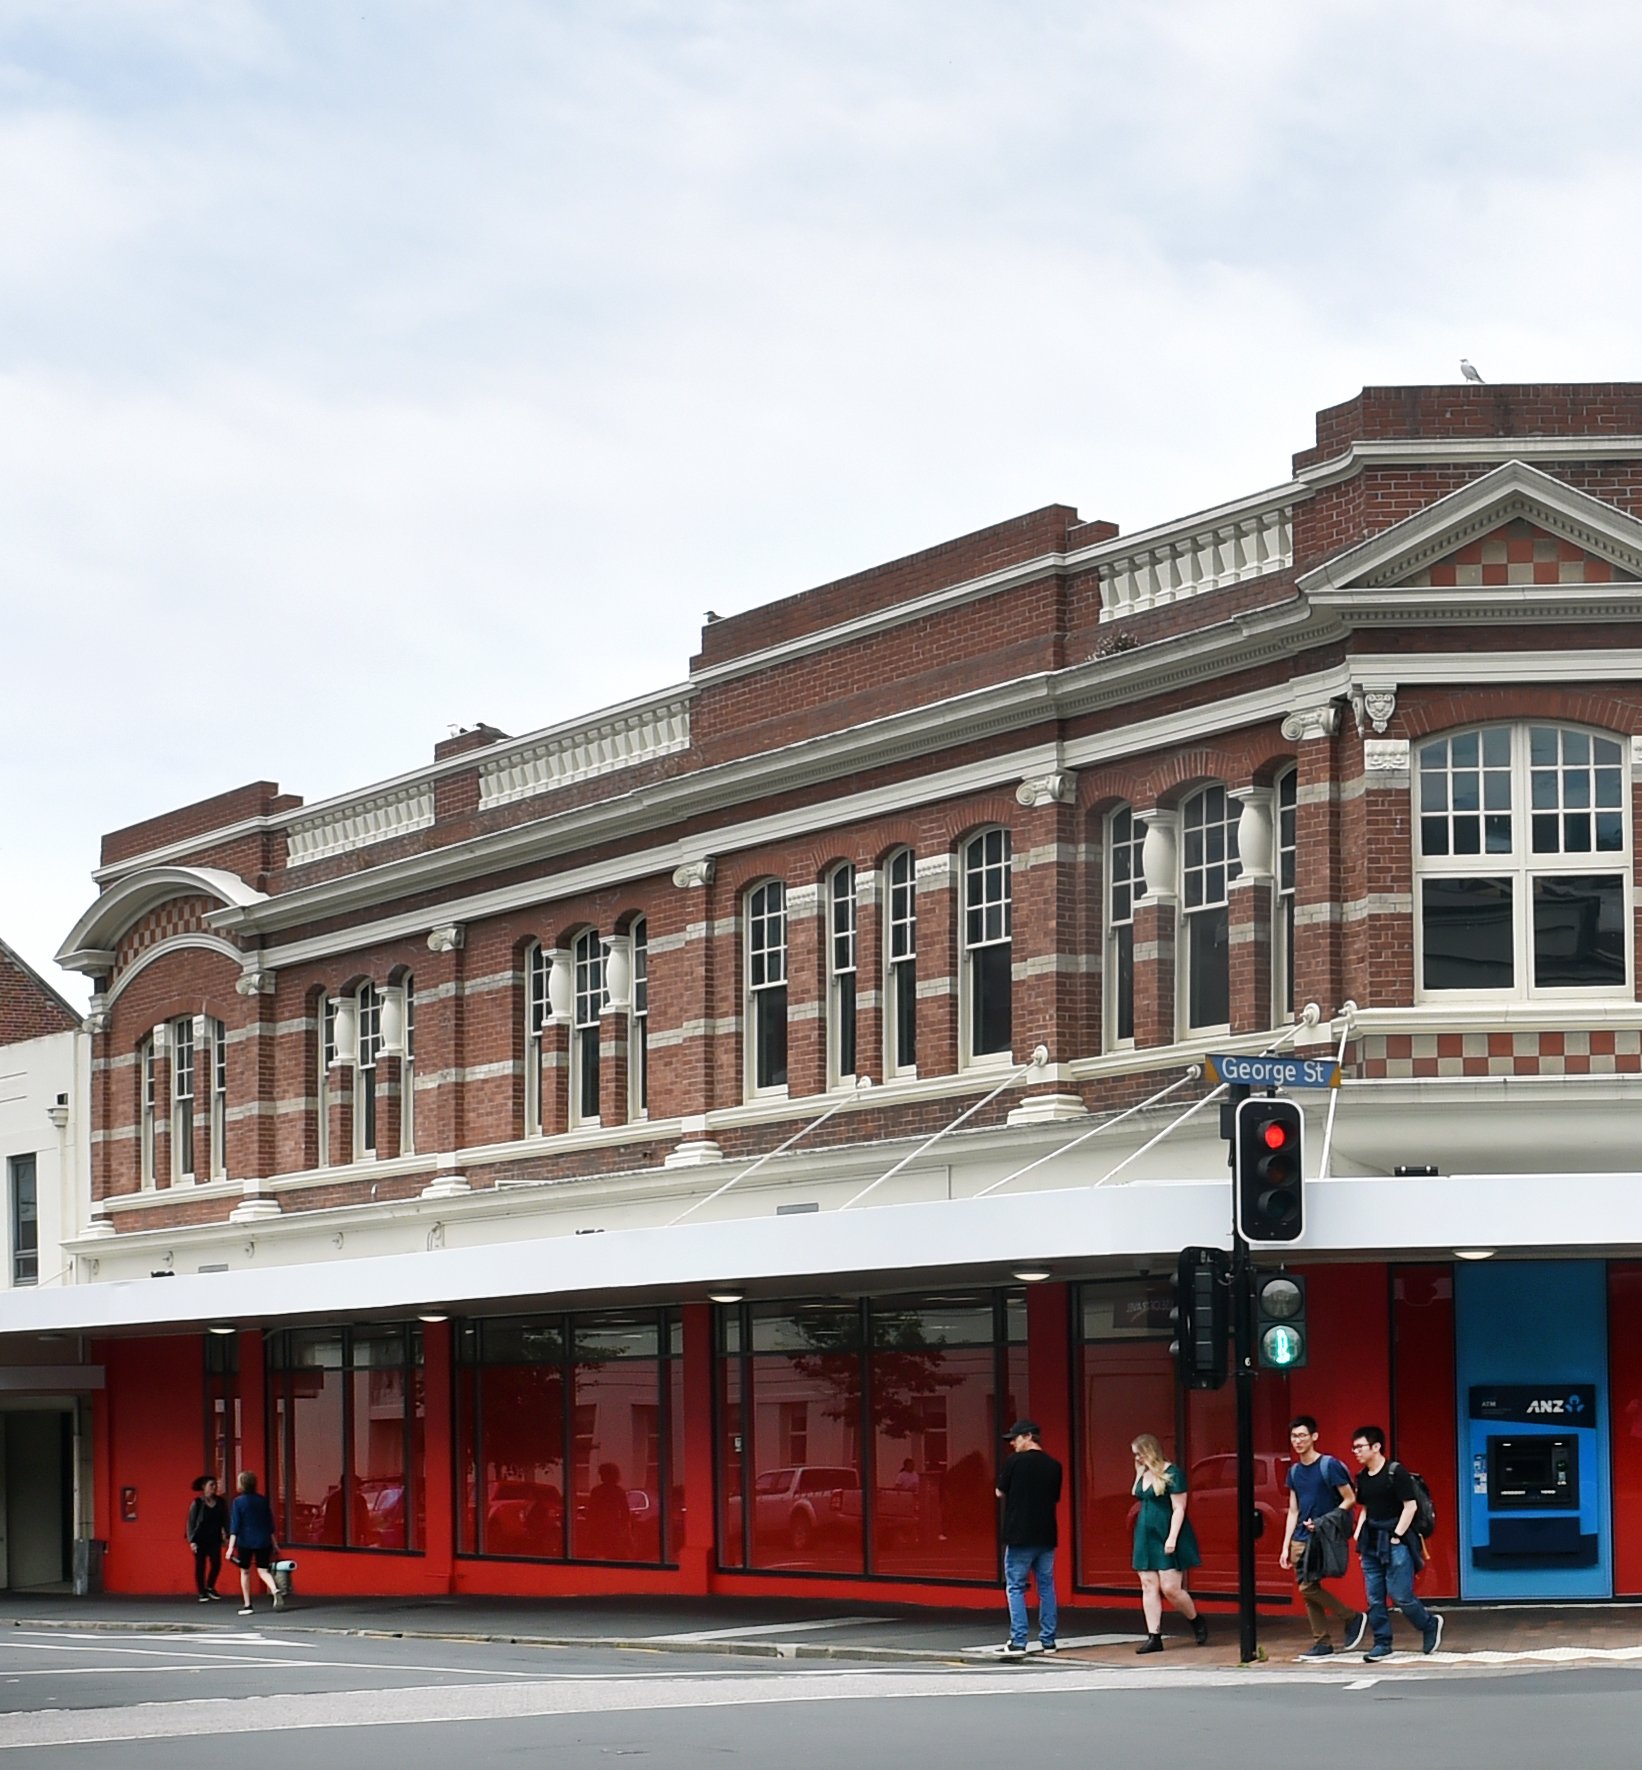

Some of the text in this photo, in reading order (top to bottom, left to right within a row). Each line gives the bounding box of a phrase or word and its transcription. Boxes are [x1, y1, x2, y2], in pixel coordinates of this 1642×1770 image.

[1222, 1057, 1324, 1087] George St
[1526, 1399, 1564, 1413] ANZ
